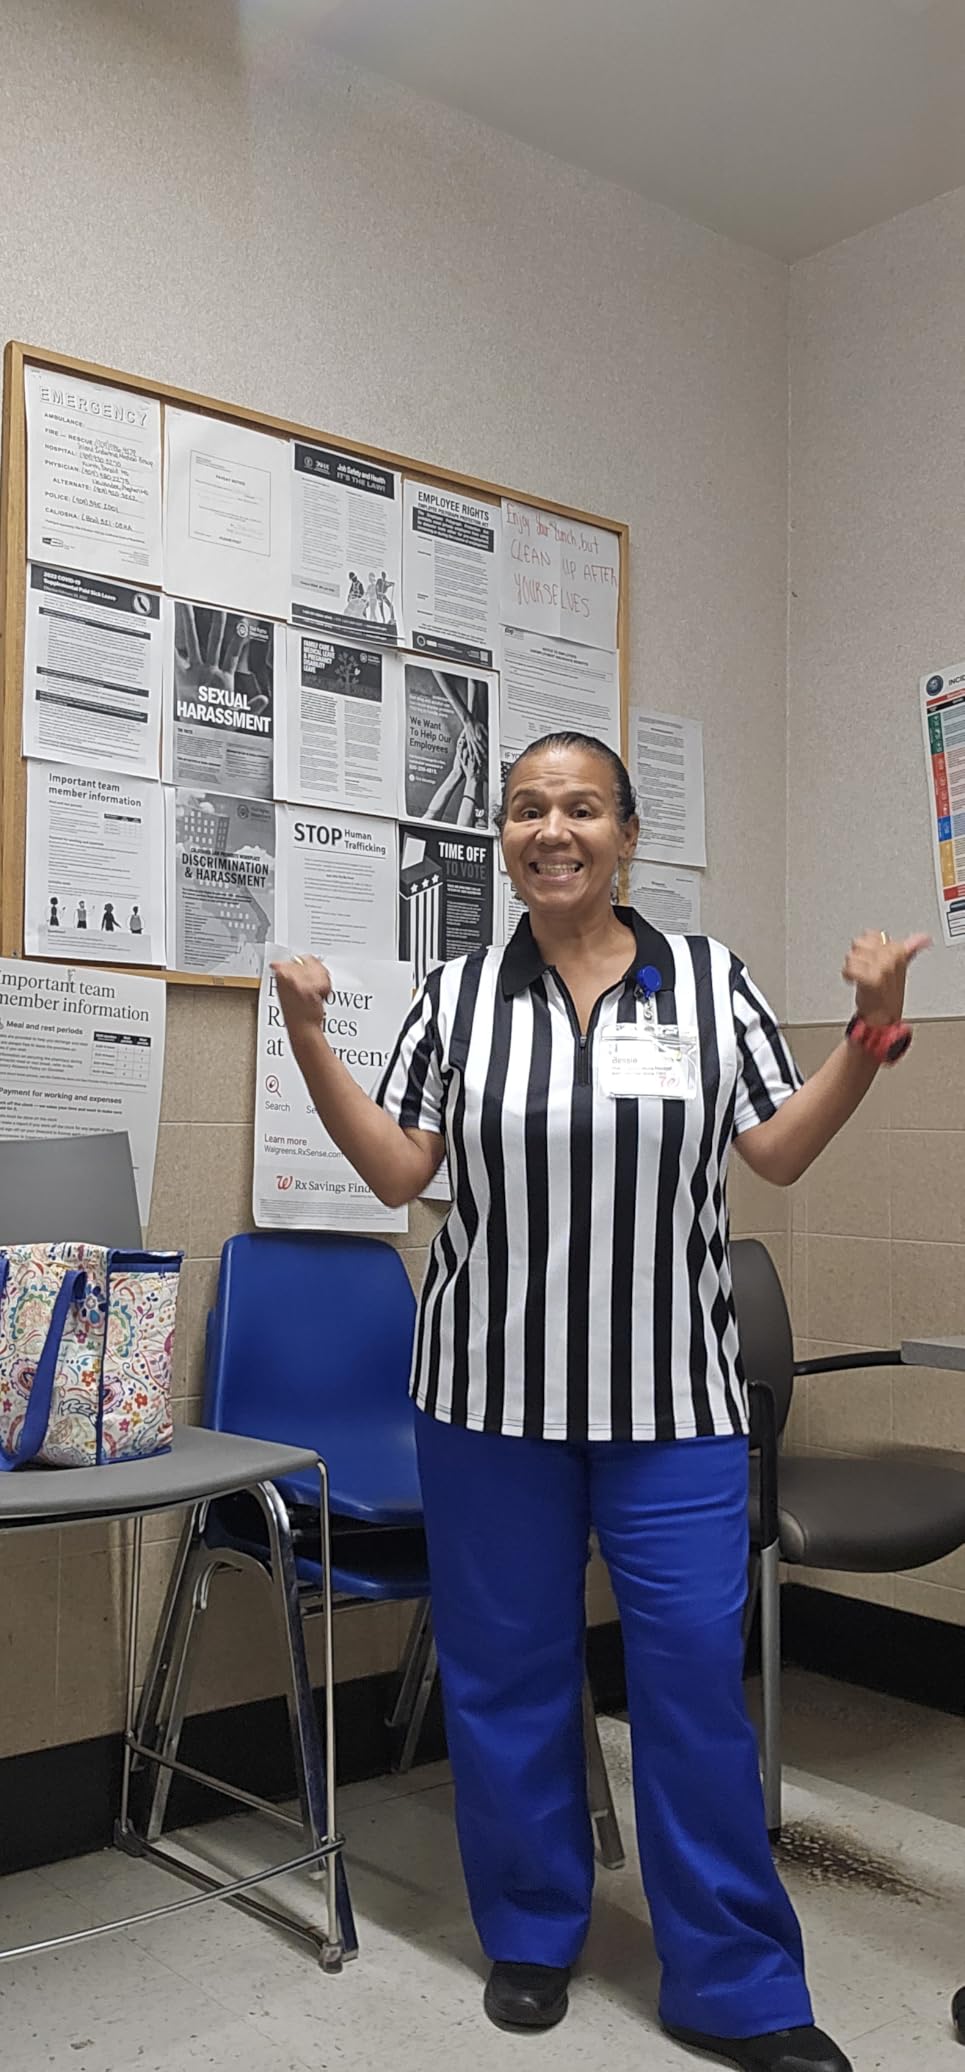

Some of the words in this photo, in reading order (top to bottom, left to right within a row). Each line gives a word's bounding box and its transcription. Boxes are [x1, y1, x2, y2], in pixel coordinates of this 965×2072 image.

[40, 387, 148, 427] EMERGENCY
[45, 427, 59, 437] FIRE
[418, 491, 461, 513] EMPLOYEE
[462, 504, 490, 522] RIGHTS
[507, 502, 531, 537] Enjoy
[511, 539, 551, 567] CLEAN
[562, 559, 577, 580] UP
[583, 564, 617, 587] AFTER
[44, 578, 79, 592] Supplemental
[79, 586, 90, 595] Paid
[90, 588, 101, 597] Sick
[101, 591, 117, 602] Leave
[514, 573, 591, 618] YOURSELVES
[198, 685, 252, 711] SEXUAL
[177, 700, 273, 734] HARASSMENT
[409, 716, 422, 727] We
[423, 719, 442, 731] Want
[409, 727, 419, 737] To
[420, 730, 438, 742] Help
[438, 733, 452, 744] Our
[409, 738, 449, 754] Employees
[49, 772, 97, 789] Important
[98, 781, 121, 792] team
[48, 786, 88, 799] member
[88, 790, 142, 808] information
[293, 822, 343, 847] STOP
[344, 829, 372, 840] Human
[344, 840, 386, 855] Trafficking
[438, 841, 465, 861] TIME
[466, 846, 488, 864] OFF
[182, 853, 269, 876] DISCRIMINATION
[445, 860, 459, 876] TO
[460, 862, 487, 881] VOTE
[184, 866, 193, 879] &
[196, 868, 267, 889] HARASSMENT
[79, 981, 116, 999] team
[63, 997, 150, 1022] information
[6, 1020, 24, 1029] Meal
[26, 1023, 39, 1031] and
[40, 1024, 55, 1032] rest
[57, 1026, 84, 1036] periods
[266, 1037, 285, 1057] at
[32, 1089, 43, 1097] for
[44, 1092, 73, 1102] working
[89, 1096, 122, 1104] expenses
[265, 1100, 291, 1112] Search
[264, 1133, 286, 1145] Learn
[286, 1137, 308, 1146] more
[295, 1180, 307, 1190] Rx
[308, 1181, 346, 1195] Savings
